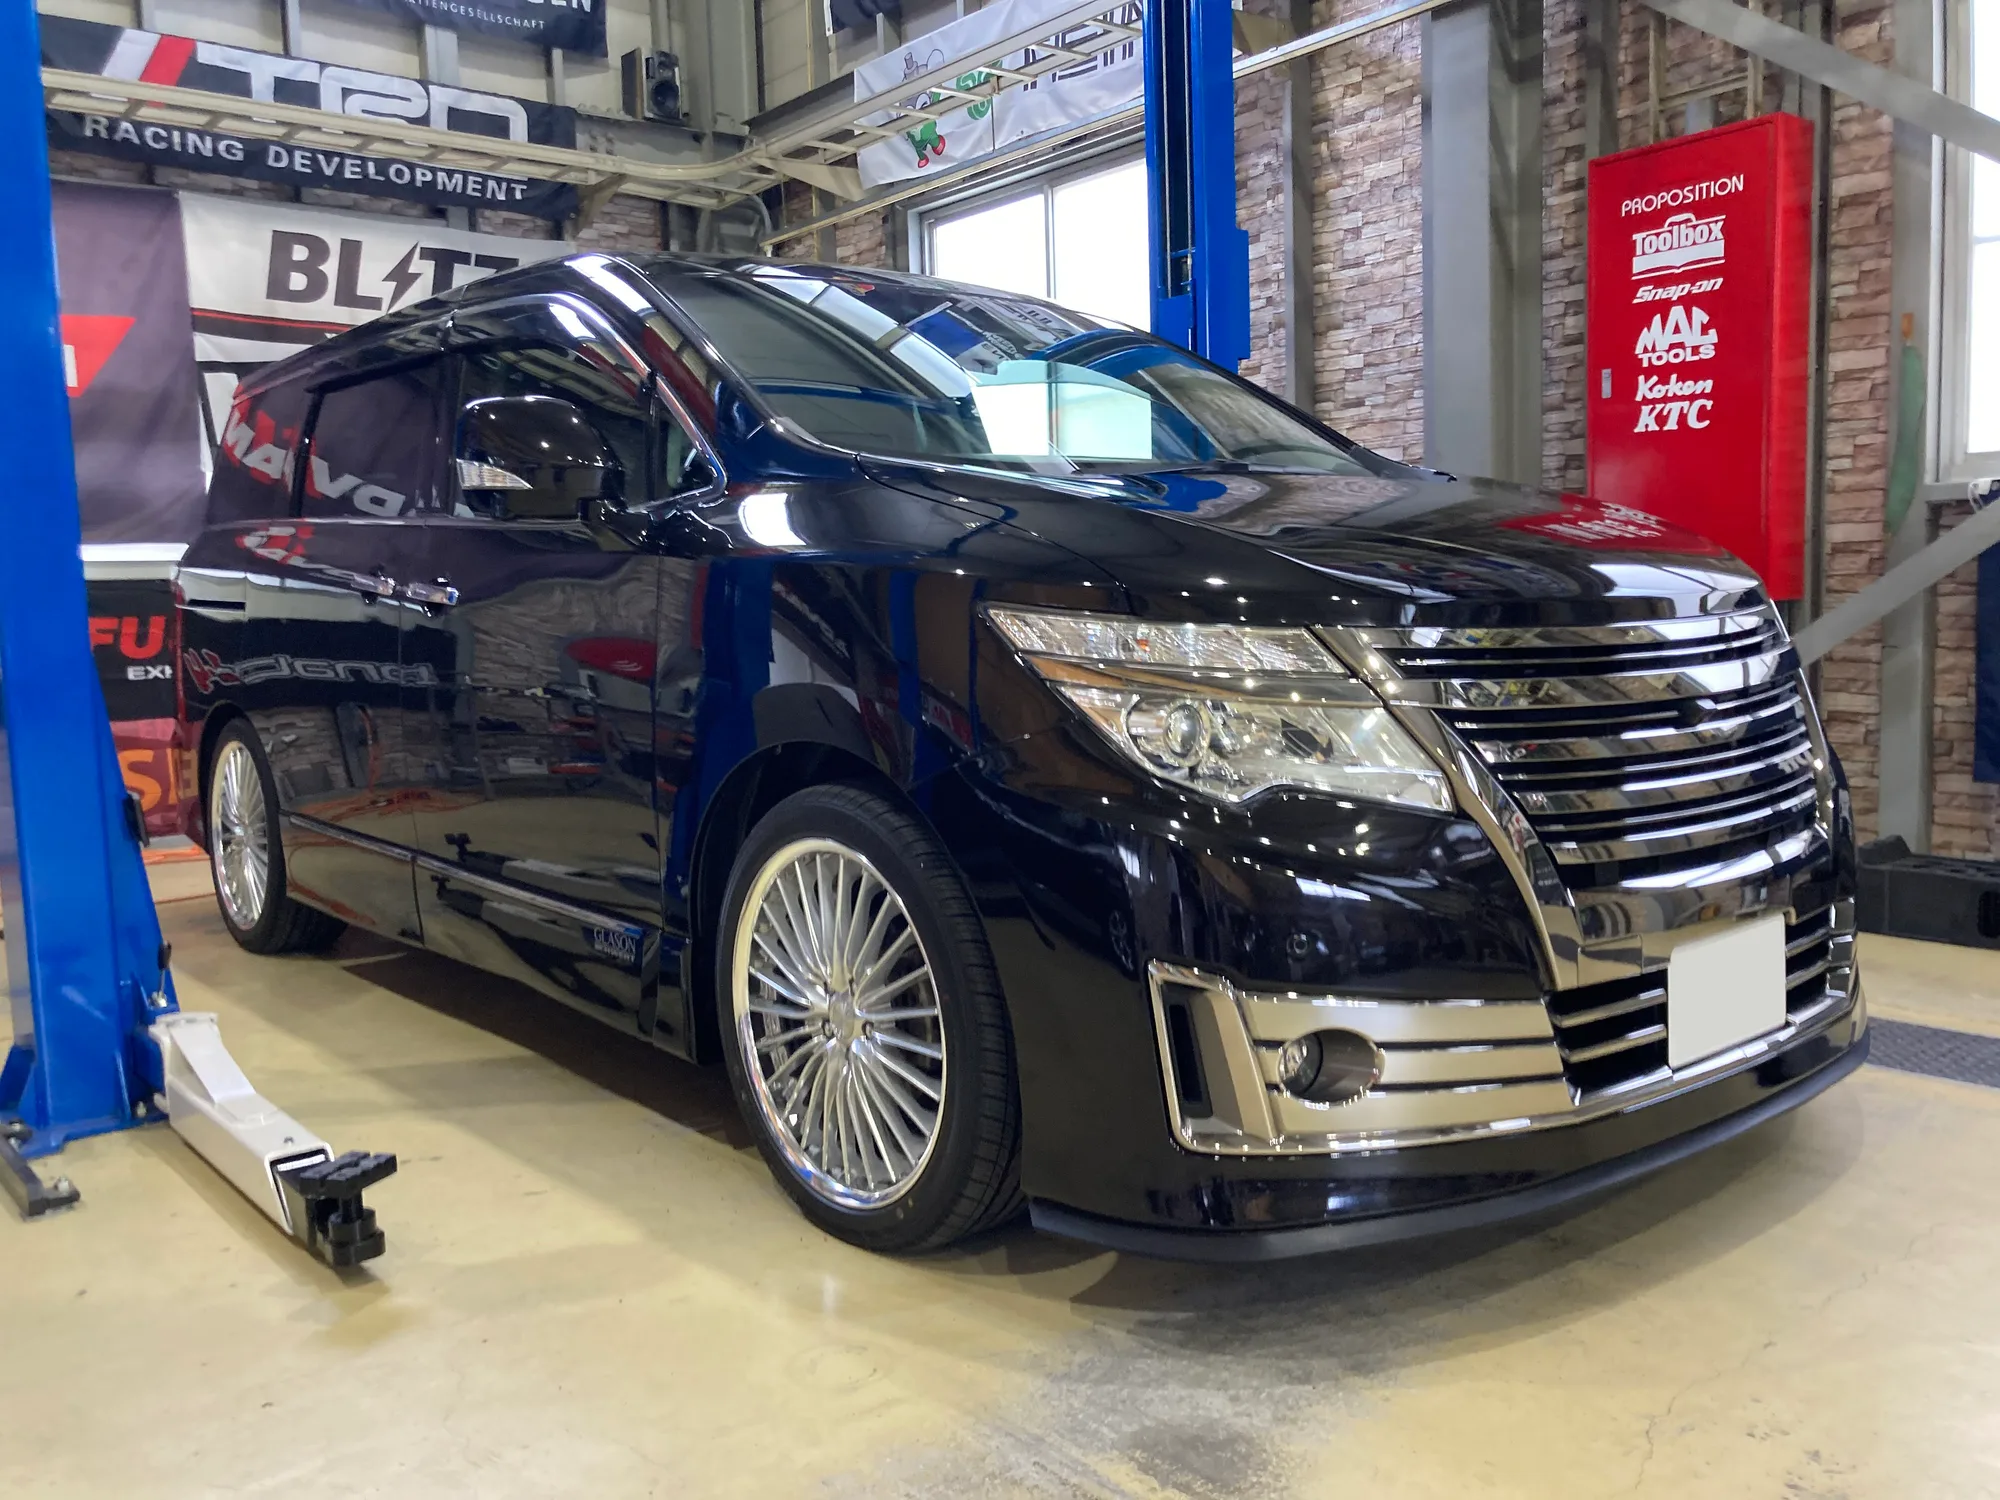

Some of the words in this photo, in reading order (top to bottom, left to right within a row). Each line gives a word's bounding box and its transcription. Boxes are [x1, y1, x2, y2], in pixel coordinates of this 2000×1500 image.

[405, 0, 545, 29] IENGESELLSCHAFT
[83, 115, 244, 161] RACING
[266, 145, 528, 200] DEVELOPMENT
[1621, 174, 1744, 216] PROPOSITION
[1632, 220, 1724, 256] Toolbox
[1632, 278, 1723, 303] Snap-on
[1634, 305, 1718, 354] MAC
[1638, 344, 1716, 367] TOOLS
[1633, 399, 1713, 433] KTC
